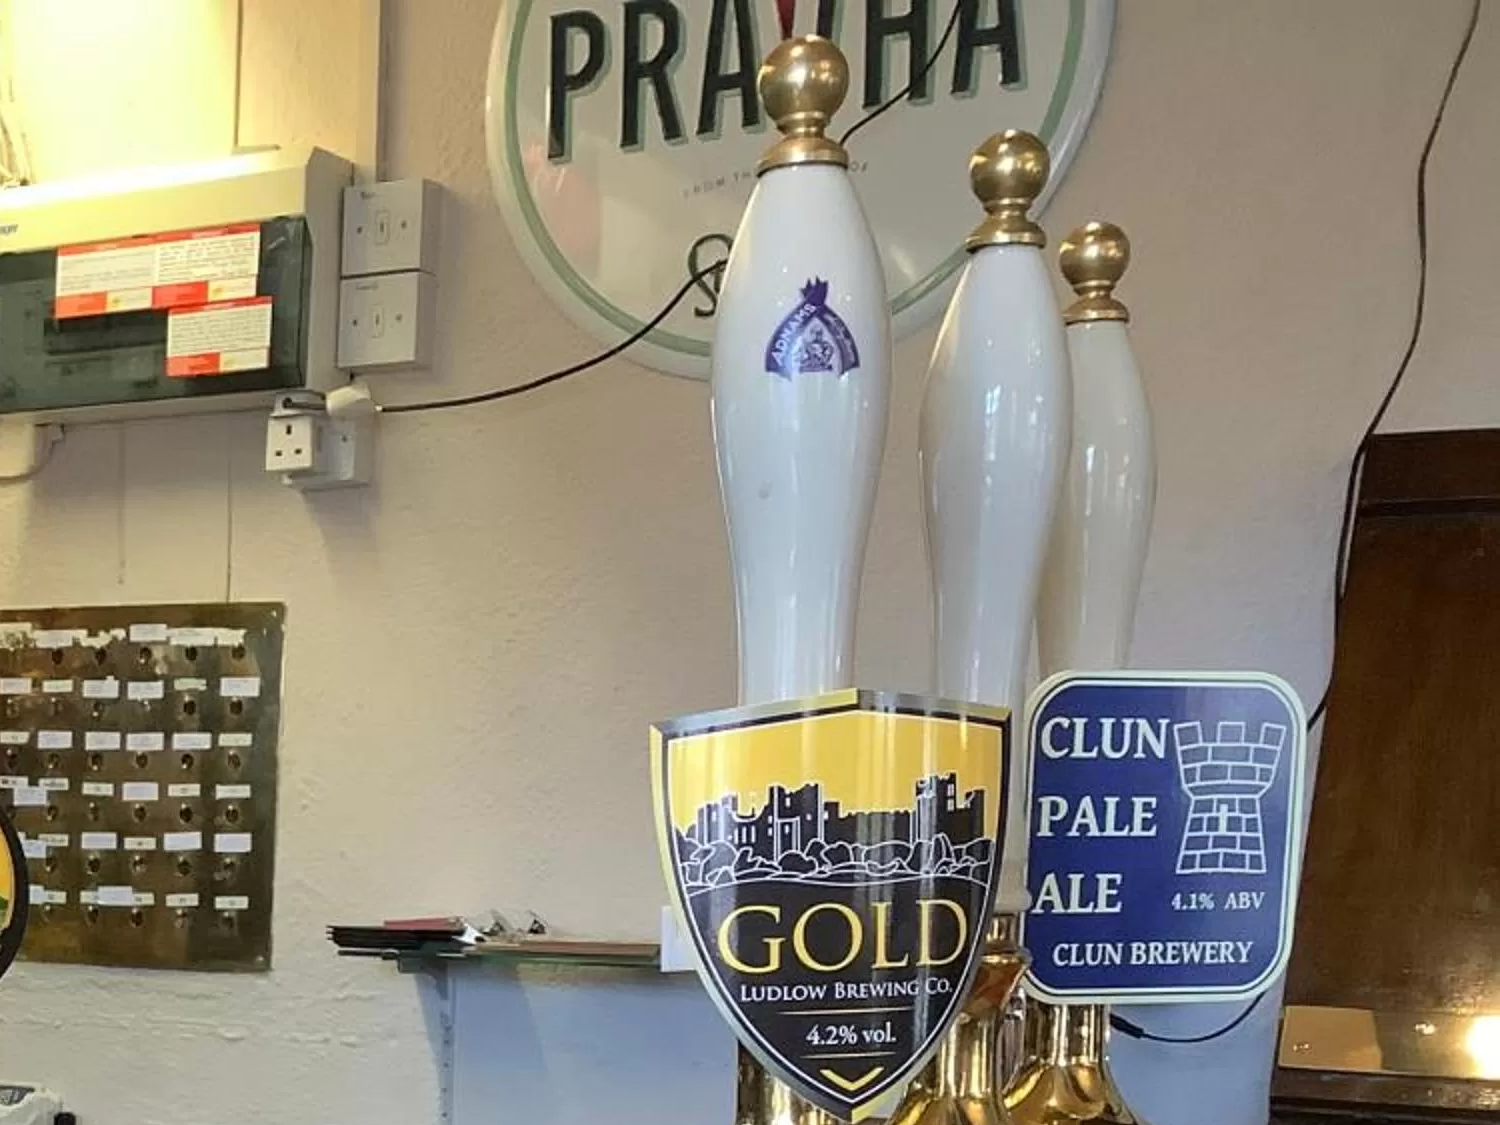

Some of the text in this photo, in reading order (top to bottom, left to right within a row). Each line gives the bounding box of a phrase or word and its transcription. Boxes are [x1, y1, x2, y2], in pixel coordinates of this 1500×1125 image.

[770, 302, 817, 367] ADNAMS
[1040, 716, 1171, 760] CLUN
[1035, 795, 1157, 837] PALE
[1030, 871, 1123, 914] ALE
[1171, 891, 1266, 911] 4.1% ABV
[716, 898, 968, 975] GOLD
[1052, 941, 1253, 966] CLUN BREWERY
[806, 1021, 897, 1046] 4.2% vol.
